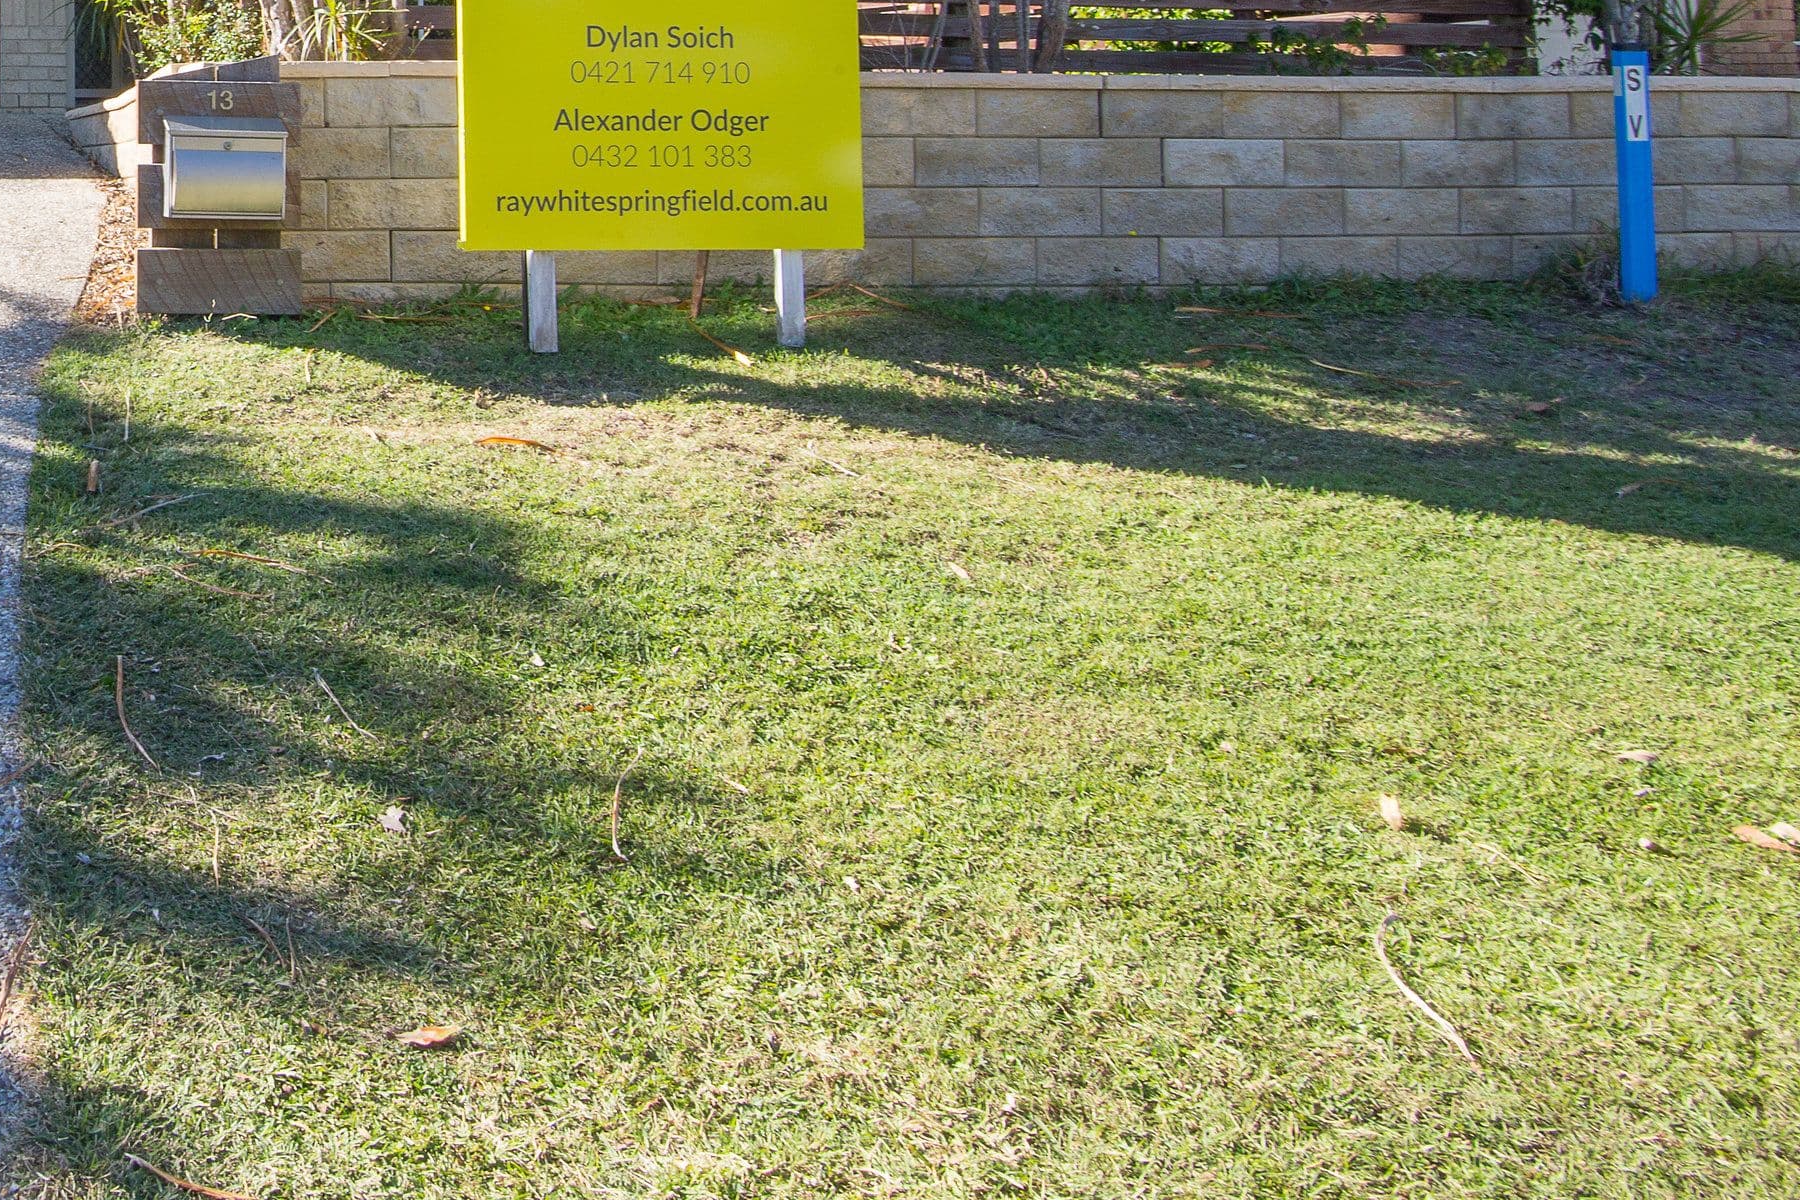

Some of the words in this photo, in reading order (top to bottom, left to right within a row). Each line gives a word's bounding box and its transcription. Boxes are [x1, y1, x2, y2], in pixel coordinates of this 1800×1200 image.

[586, 25, 659, 52] Dylan
[666, 25, 734, 49] Soich
[570, 61, 636, 84] 0421
[646, 61, 694, 84] 714
[702, 61, 751, 85] 910
[207, 90, 234, 110] 13
[552, 109, 683, 132] Alexander
[690, 109, 770, 137] Odger
[572, 145, 638, 168] 0432
[648, 145, 695, 168] 101
[704, 145, 752, 168] 383
[496, 189, 828, 217] raywhitespringfield.com.au
